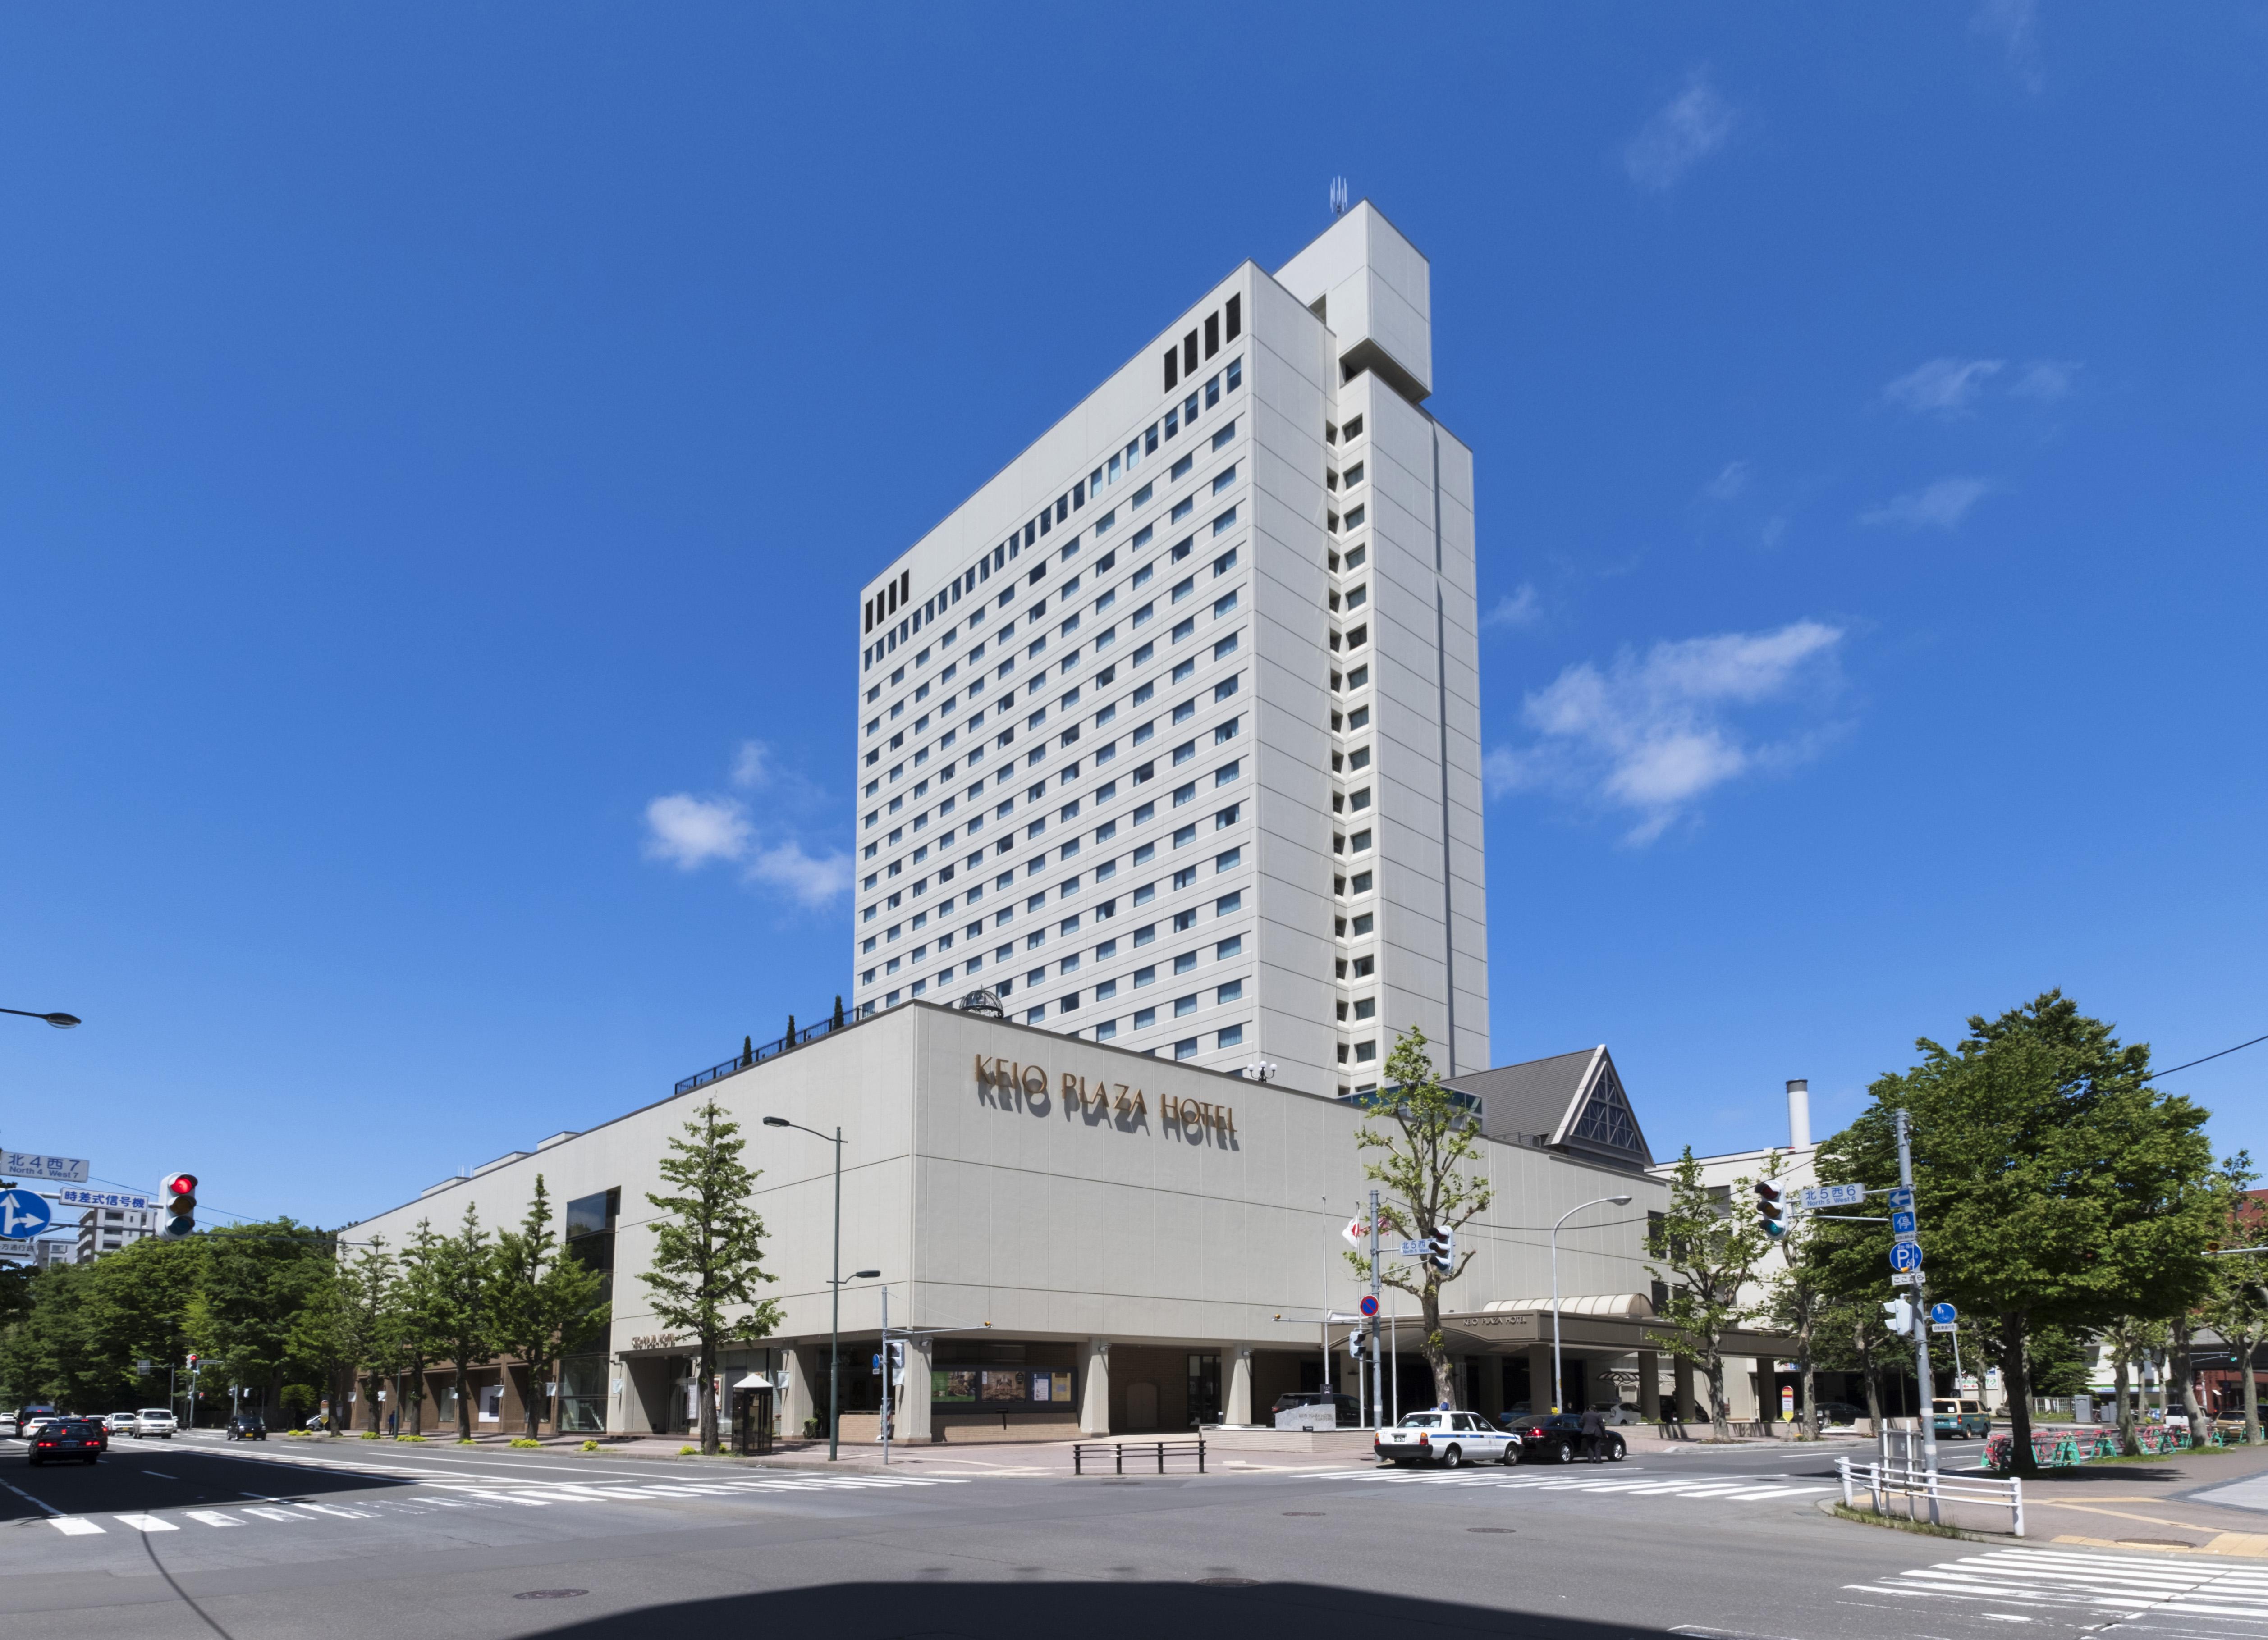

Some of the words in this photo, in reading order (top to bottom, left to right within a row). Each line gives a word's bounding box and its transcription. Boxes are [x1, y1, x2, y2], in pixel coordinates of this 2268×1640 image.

[976, 1054, 1048, 1094] KEIO
[1062, 1073, 1147, 1115] PLAZA
[1160, 1093, 1238, 1133] HOTEL
[8, 1154, 80, 1172] 北4西7
[9, 1166, 35, 1175] North
[49, 1170, 71, 1179] West
[64, 1191, 145, 1208] 時差式信号機
[1805, 1185, 1856, 1200] 北5西6
[1897, 1215, 1911, 1229] 停
[0, 1243, 34, 1252] 方通行路
[1897, 1249, 1909, 1267] P
[1482, 1316, 1503, 1325] PLAZA
[1506, 1316, 1526, 1324] HOTEL
